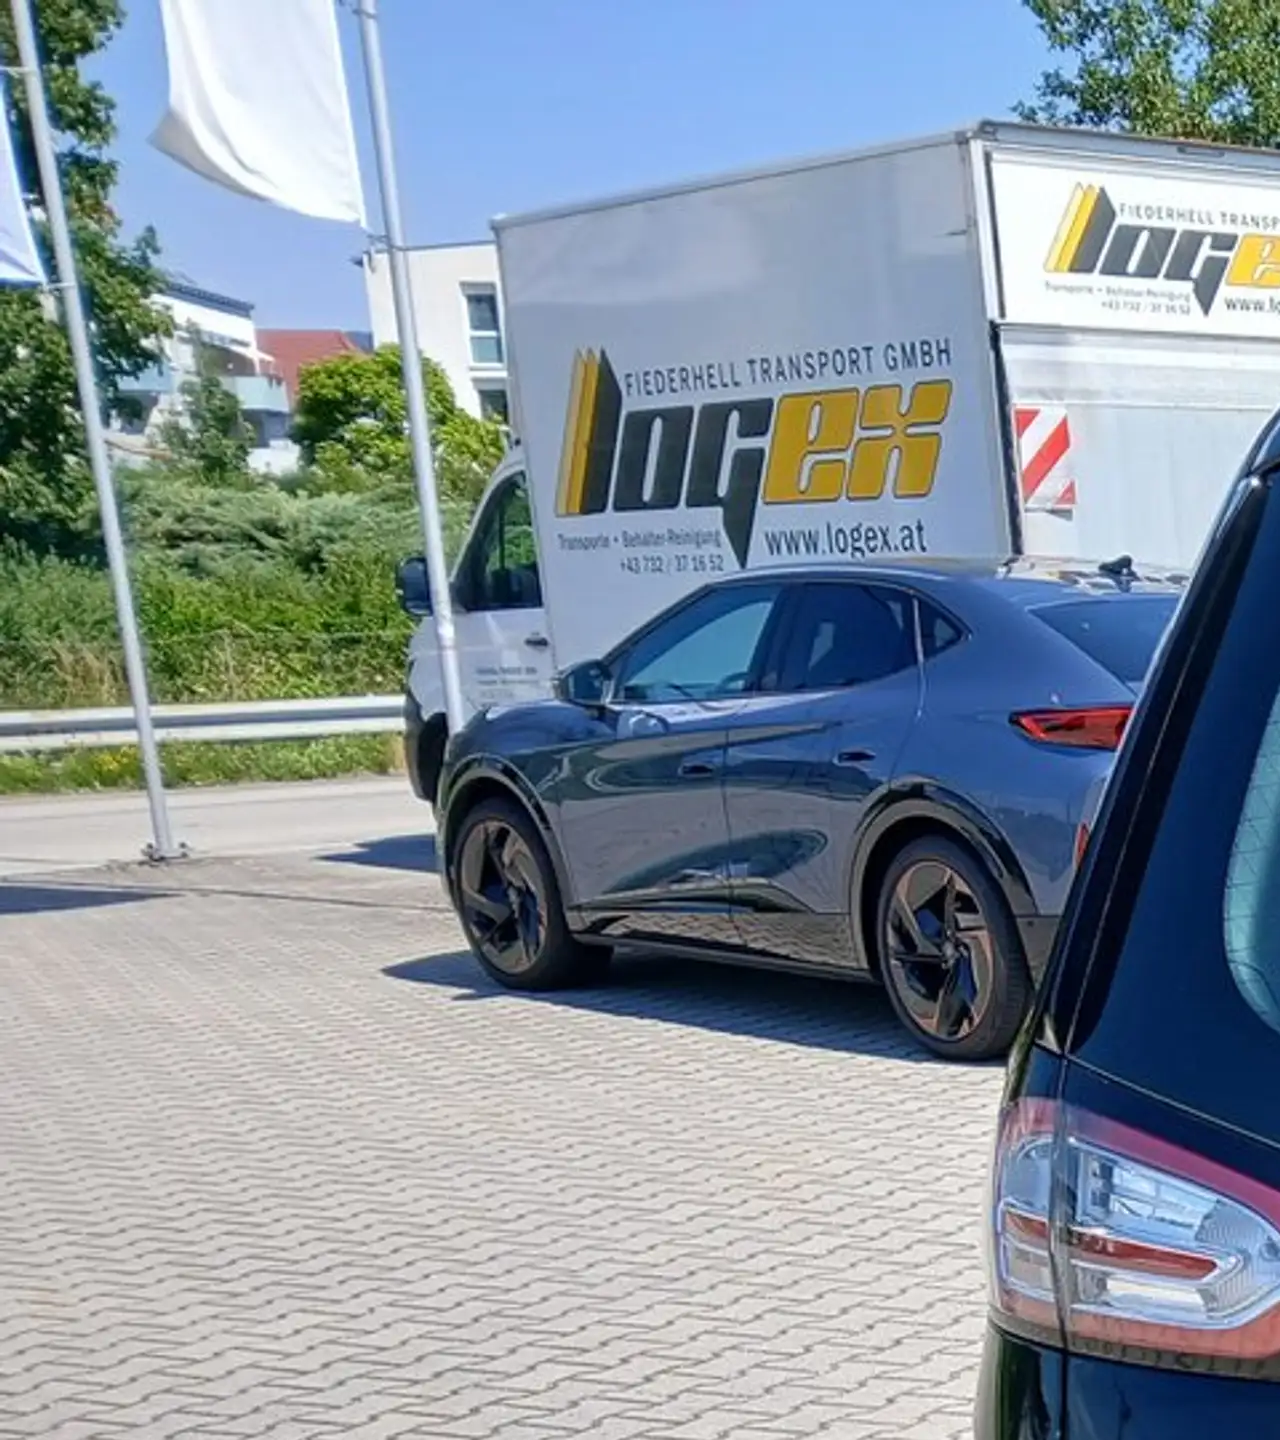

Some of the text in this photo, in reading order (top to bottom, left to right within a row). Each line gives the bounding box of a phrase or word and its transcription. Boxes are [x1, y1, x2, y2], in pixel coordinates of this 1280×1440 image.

[1119, 203, 1214, 226] FIEDERHELL
[624, 337, 952, 397] FIEDERHELL TRANSPORT GMBH
[554, 347, 953, 569] logex
[764, 517, 928, 559] www.logex.at
